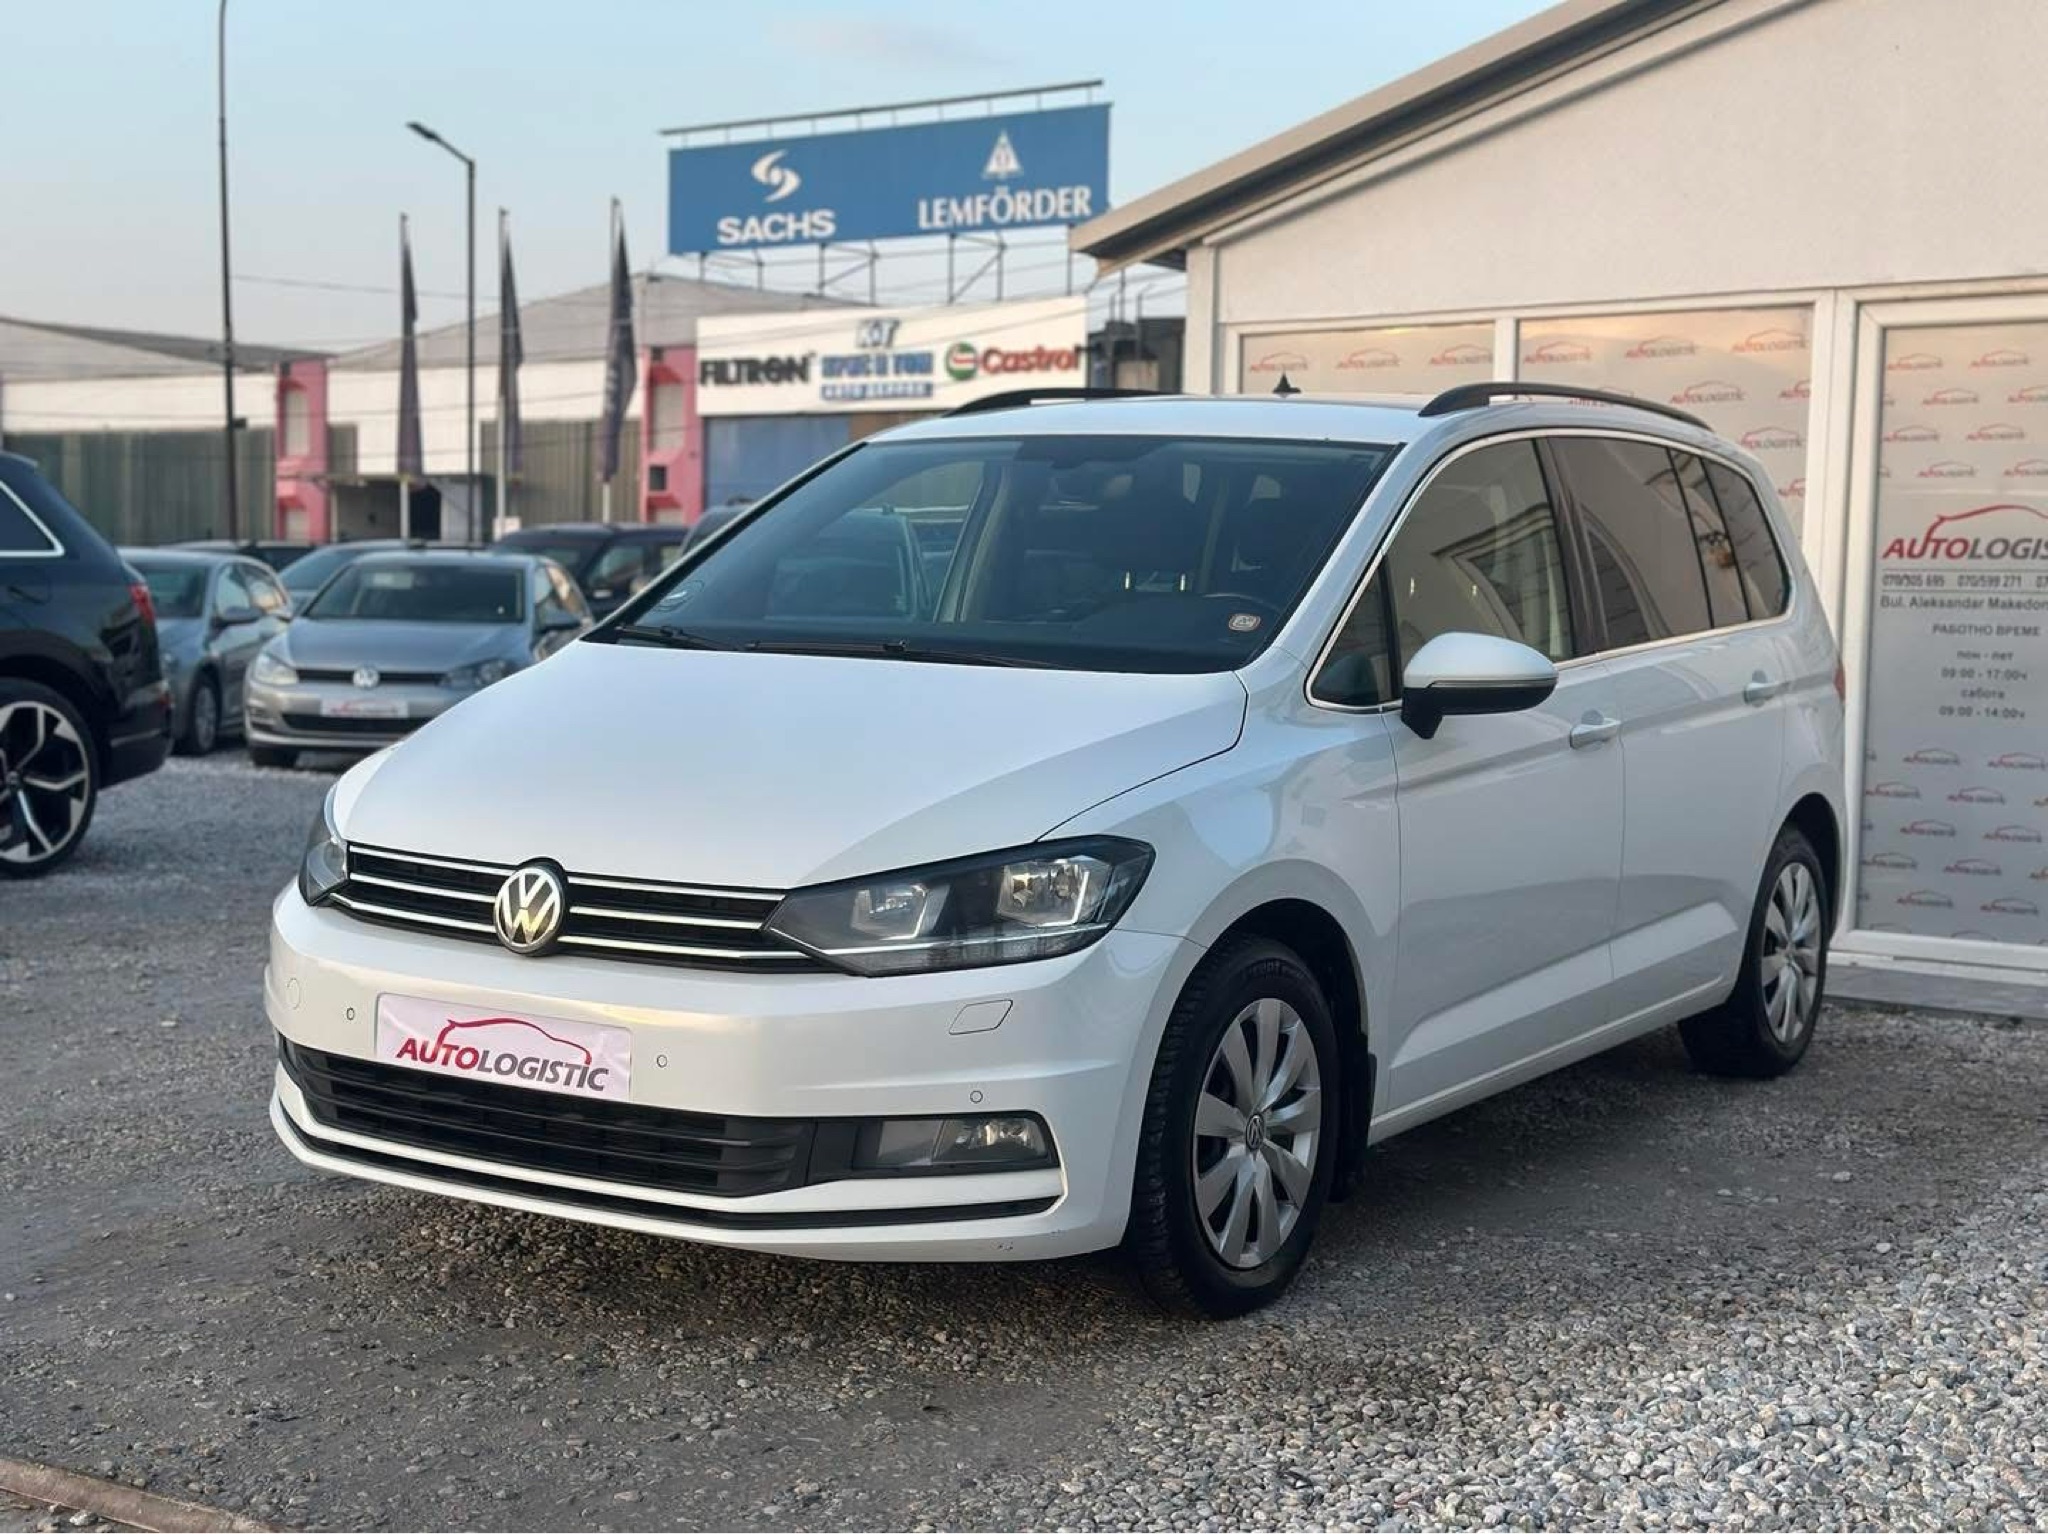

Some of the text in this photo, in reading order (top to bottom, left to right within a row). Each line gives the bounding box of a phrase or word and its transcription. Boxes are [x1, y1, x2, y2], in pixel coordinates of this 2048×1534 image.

[918, 185, 1092, 229] LEMFÖRDER
[717, 209, 836, 245] SACHS
[699, 356, 809, 386] FILTRON
[983, 344, 1080, 373] Castrol
[1909, 597, 1984, 609] Aleksandar
[396, 1028, 609, 1092] AUTOLOGISTIC
